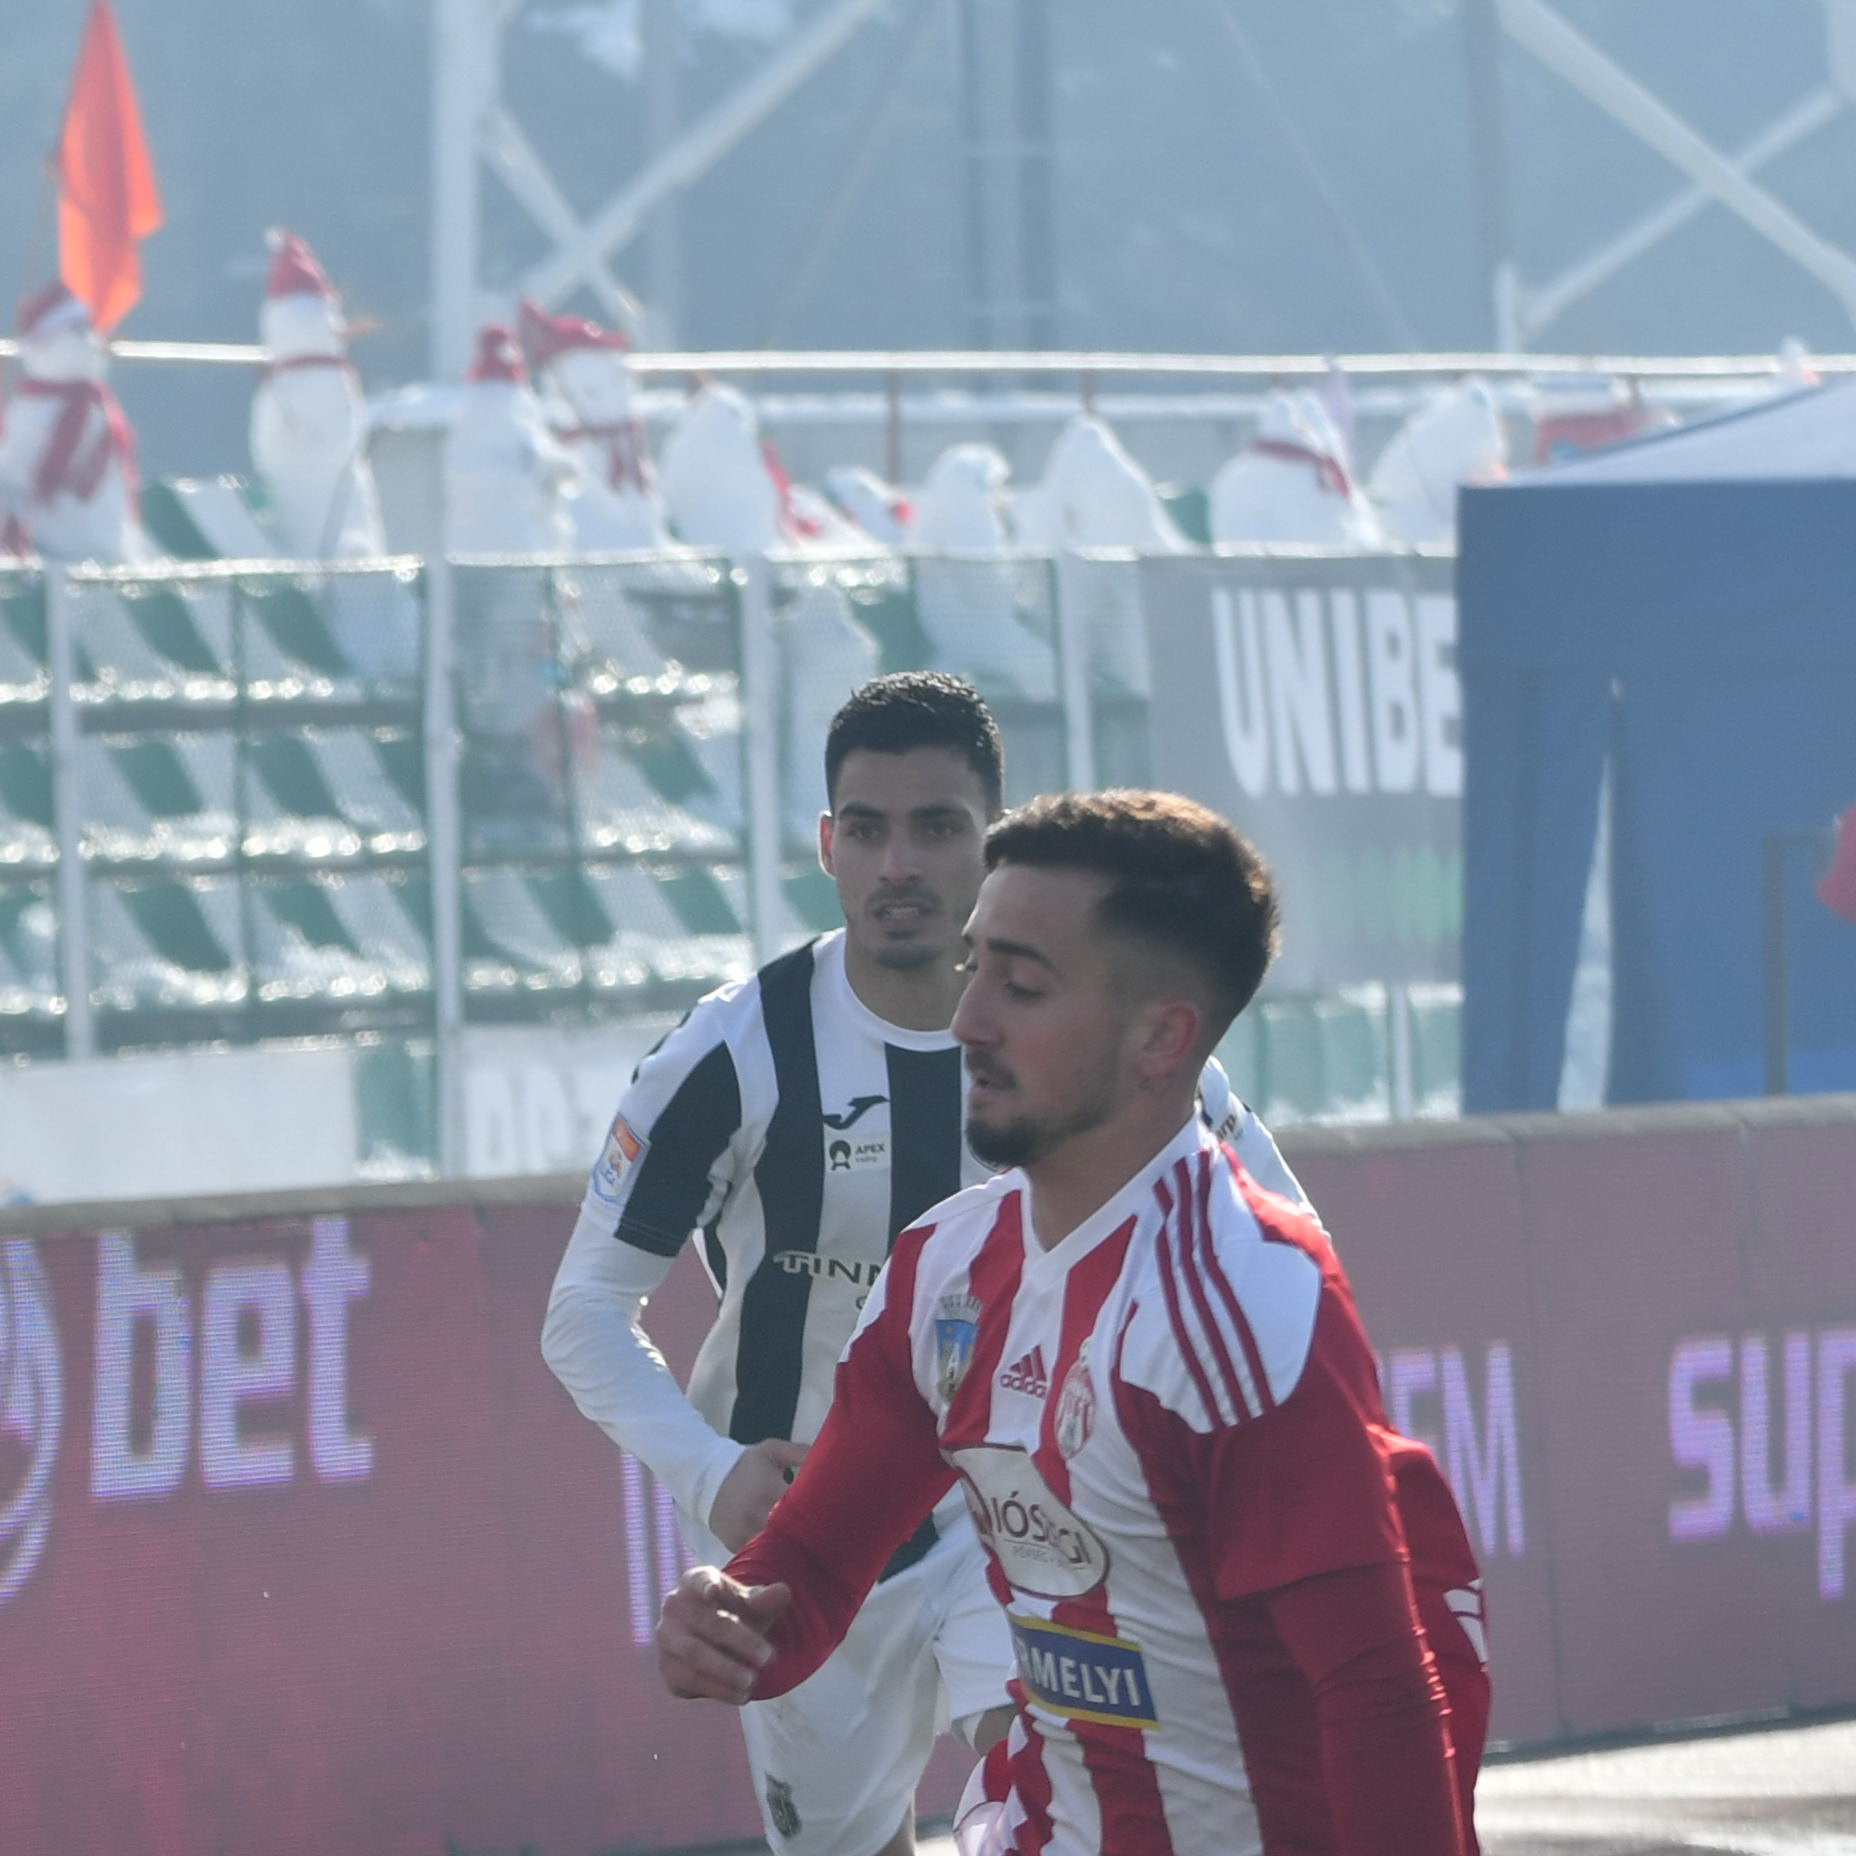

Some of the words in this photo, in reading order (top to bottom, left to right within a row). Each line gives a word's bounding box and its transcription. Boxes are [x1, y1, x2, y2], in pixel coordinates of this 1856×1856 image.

[855, 1143, 886, 1155] APEX
[88, 1214, 373, 1502] bet
[999, 1374, 1048, 1400] adida
